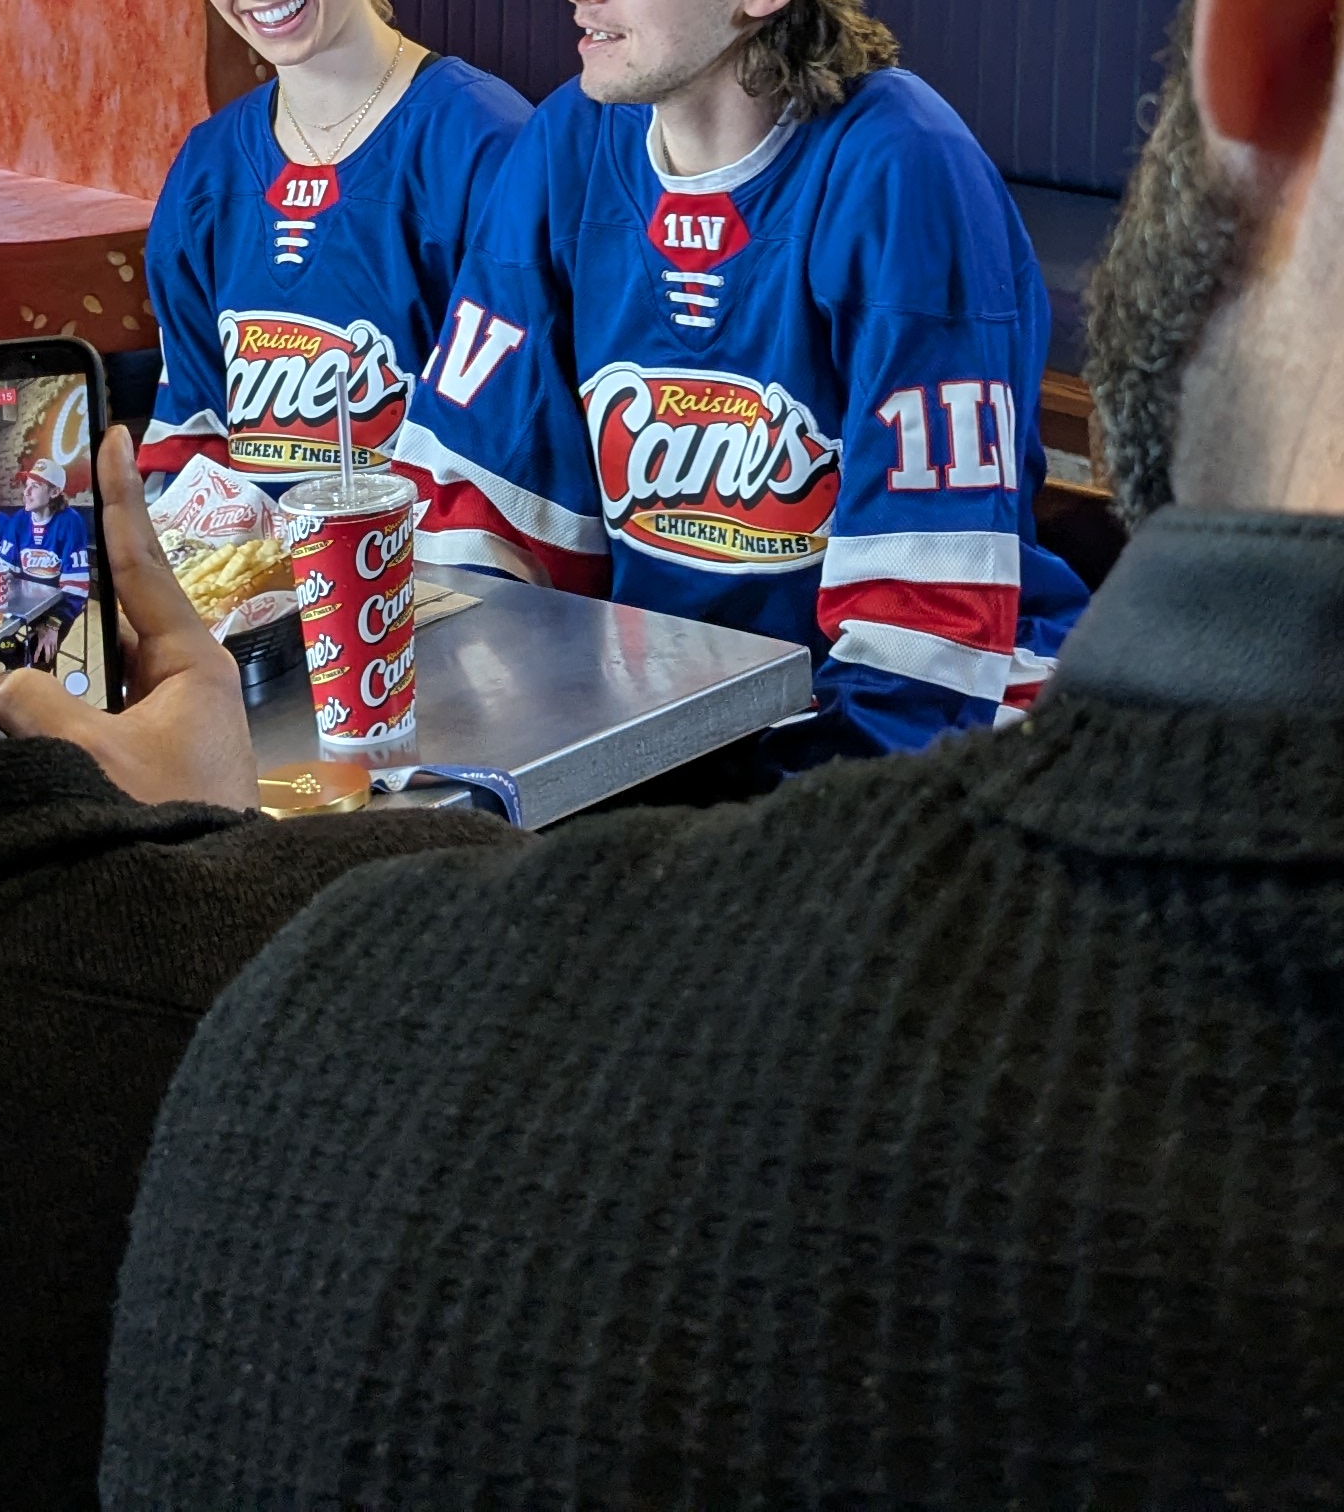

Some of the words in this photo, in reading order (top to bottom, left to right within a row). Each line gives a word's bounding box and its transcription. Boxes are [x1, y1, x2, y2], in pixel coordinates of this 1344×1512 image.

[282, 179, 329, 208] 1LV
[663, 213, 726, 251] 1LV
[240, 325, 322, 359] Raising
[421, 299, 524, 406] V
[657, 385, 759, 427] Raising
[587, 370, 836, 520] Cane's
[196, 503, 257, 537] Cane's
[287, 515, 325, 546] nes
[656, 514, 727, 544] CHICKEN
[731, 528, 809, 554] FINGERS
[296, 571, 334, 612] ne's
[305, 633, 342, 673] ne's
[316, 696, 351, 735] ne's
